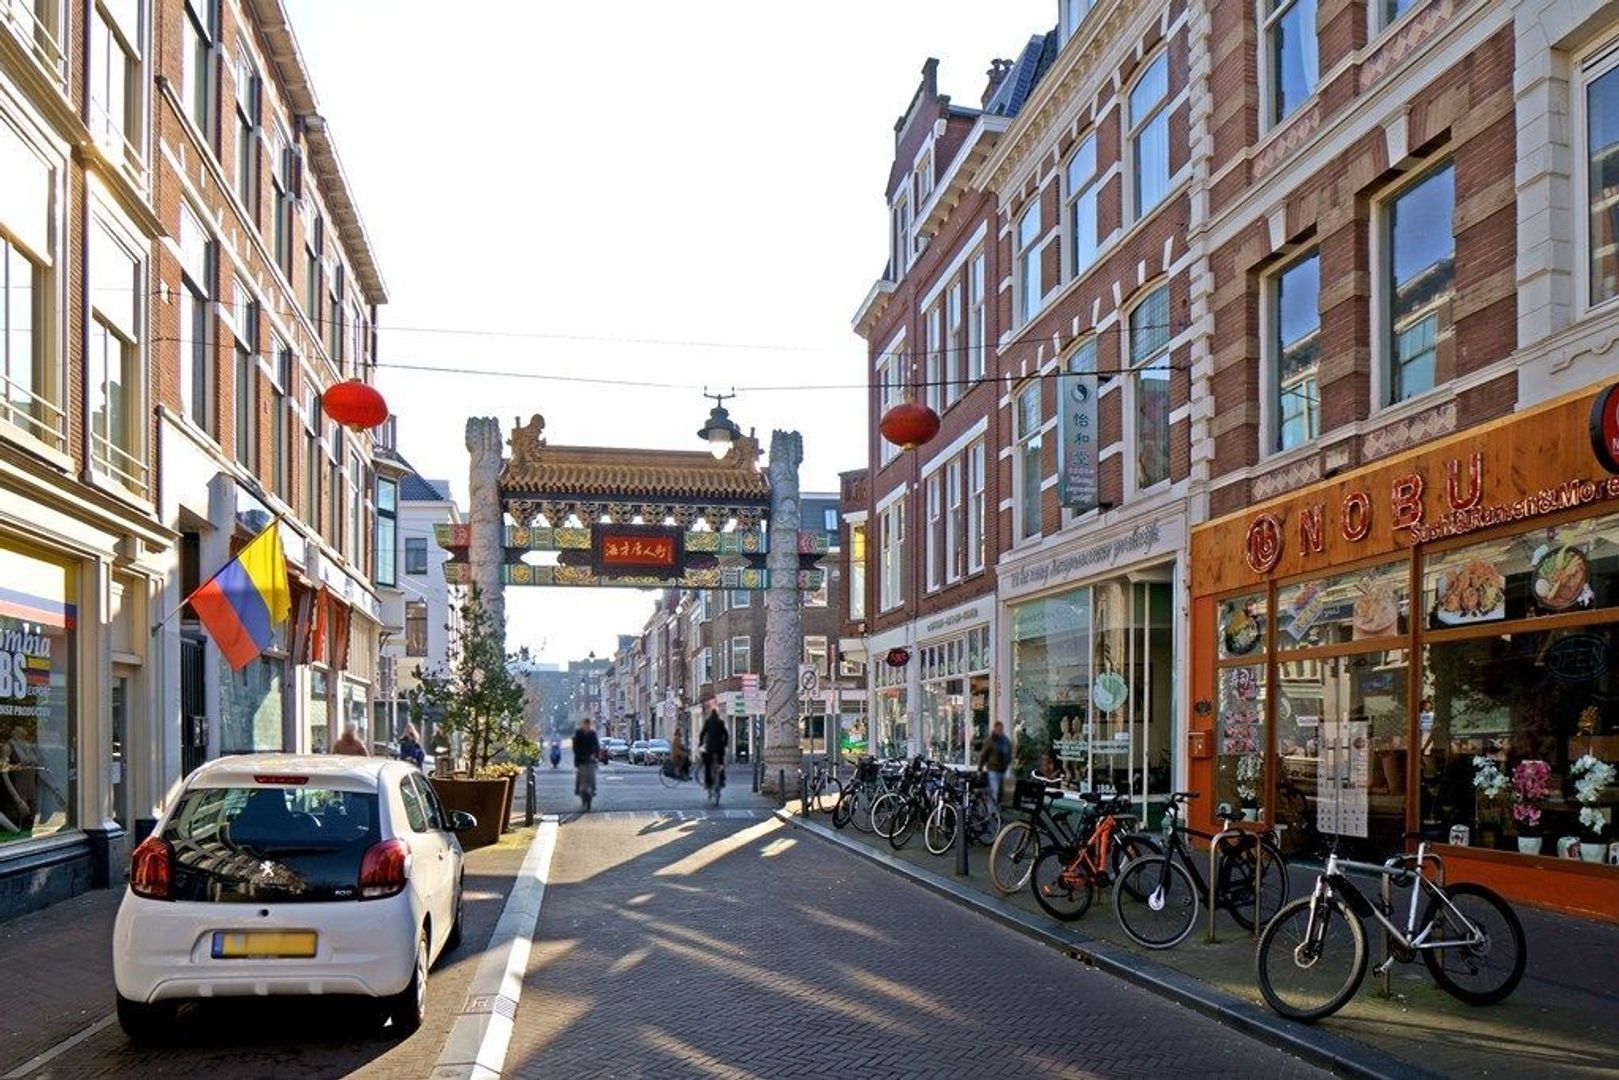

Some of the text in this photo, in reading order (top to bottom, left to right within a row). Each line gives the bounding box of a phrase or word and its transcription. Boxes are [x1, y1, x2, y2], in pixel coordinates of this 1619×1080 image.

[1073, 412, 1089, 466] 怡和堂
[1299, 453, 1482, 556] NOBU
